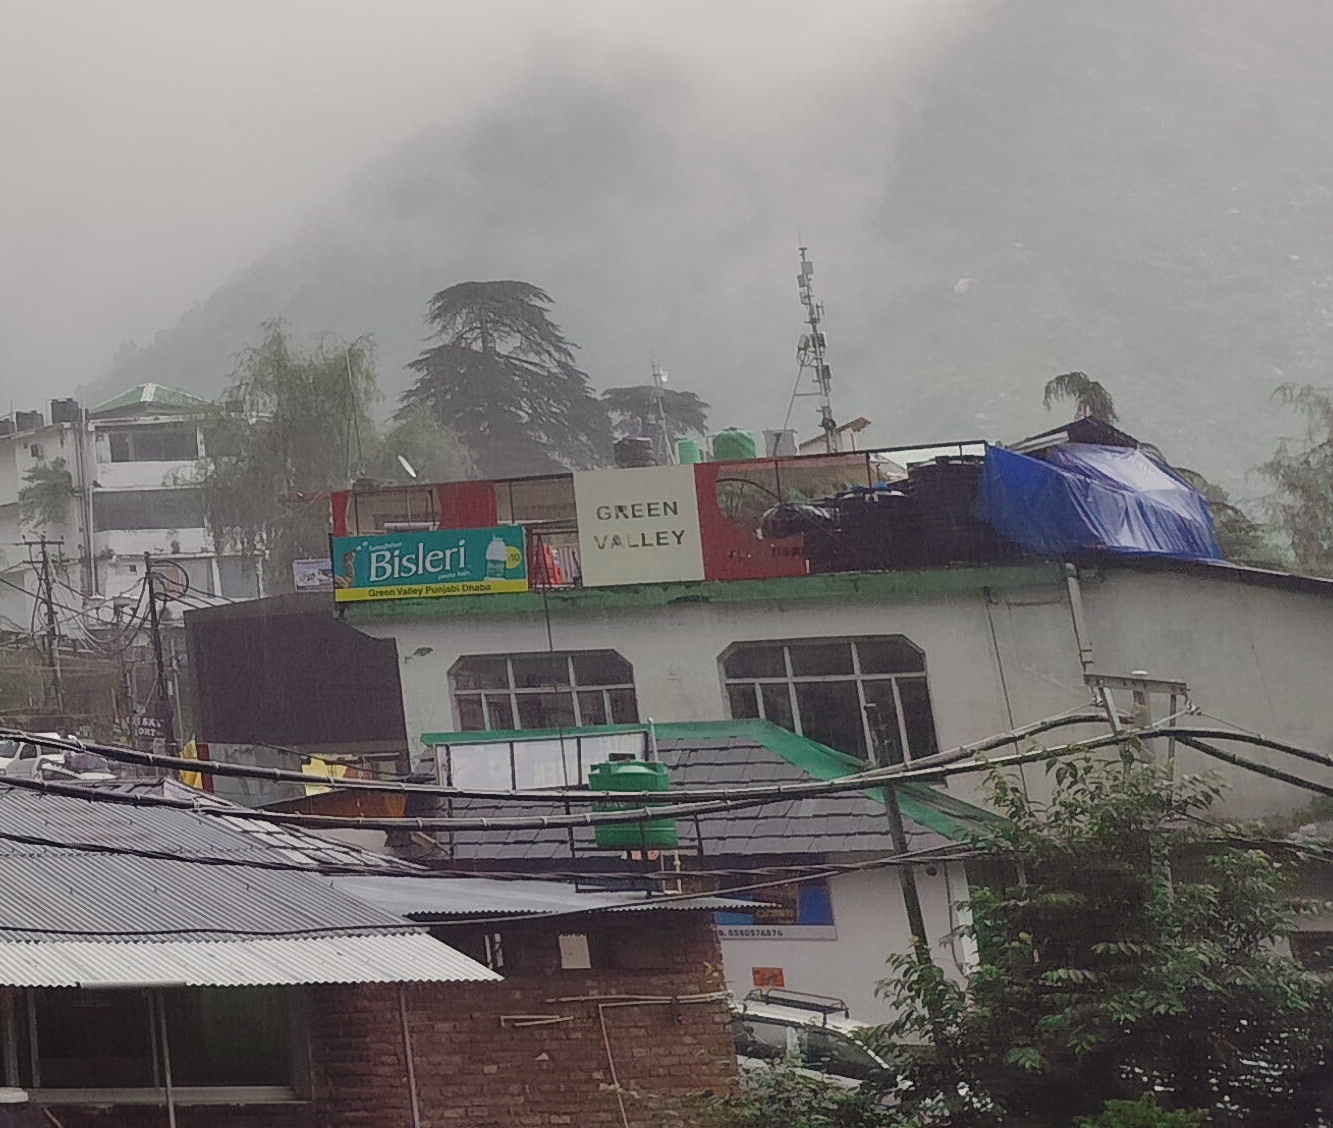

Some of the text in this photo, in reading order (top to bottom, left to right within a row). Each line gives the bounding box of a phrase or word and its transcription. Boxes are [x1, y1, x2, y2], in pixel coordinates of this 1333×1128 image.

[596, 501, 678, 521] GREEN
[593, 529, 686, 550] VALLEY
[369, 539, 466, 582] Bisleri
[368, 583, 491, 597] Green Valley Punjabi Dhaba
